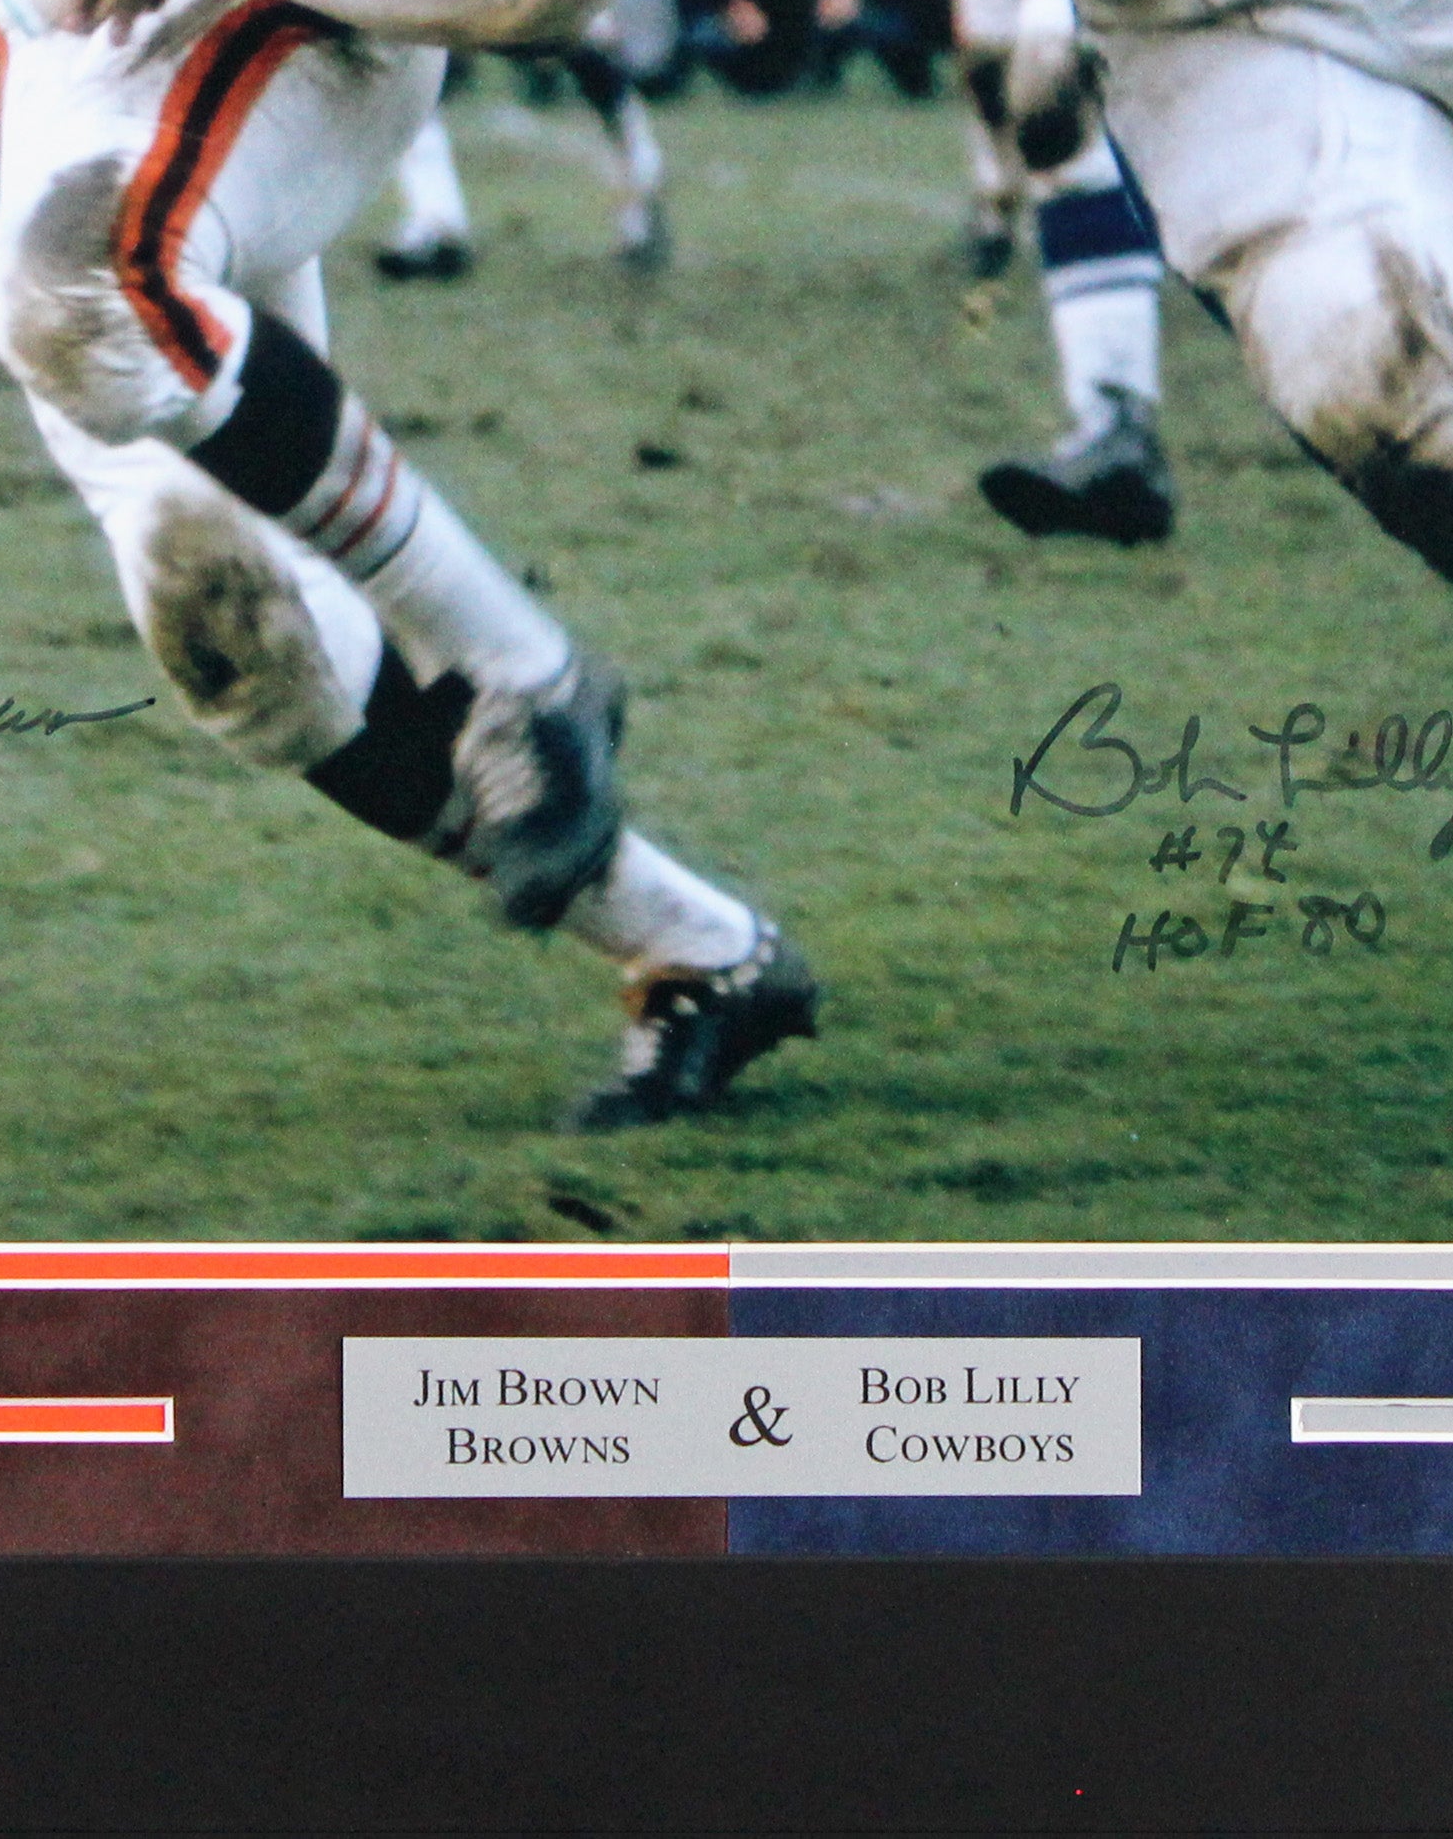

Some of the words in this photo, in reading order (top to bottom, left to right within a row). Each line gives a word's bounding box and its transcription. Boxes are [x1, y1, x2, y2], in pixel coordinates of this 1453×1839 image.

[1009, 681, 1248, 817] Bob
[1111, 899, 1276, 973] HOF
[1297, 891, 1387, 957] 80
[729, 1385, 794, 1447] &
